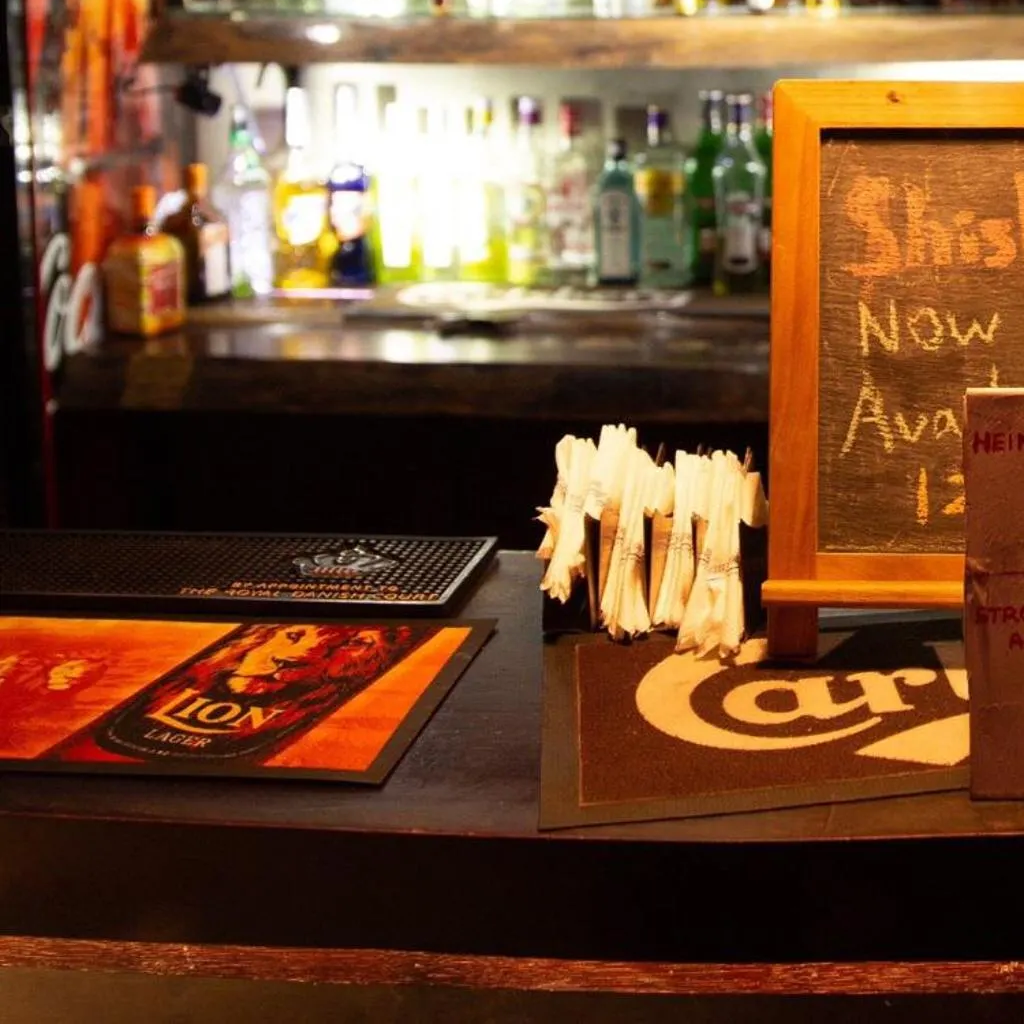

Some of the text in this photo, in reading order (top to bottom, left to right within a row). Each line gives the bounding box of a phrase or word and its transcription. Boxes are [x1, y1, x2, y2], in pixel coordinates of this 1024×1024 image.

[255, 581, 374, 592] APPOINTMENT
[145, 687, 285, 734] LION
[144, 728, 213, 749] LAGER
